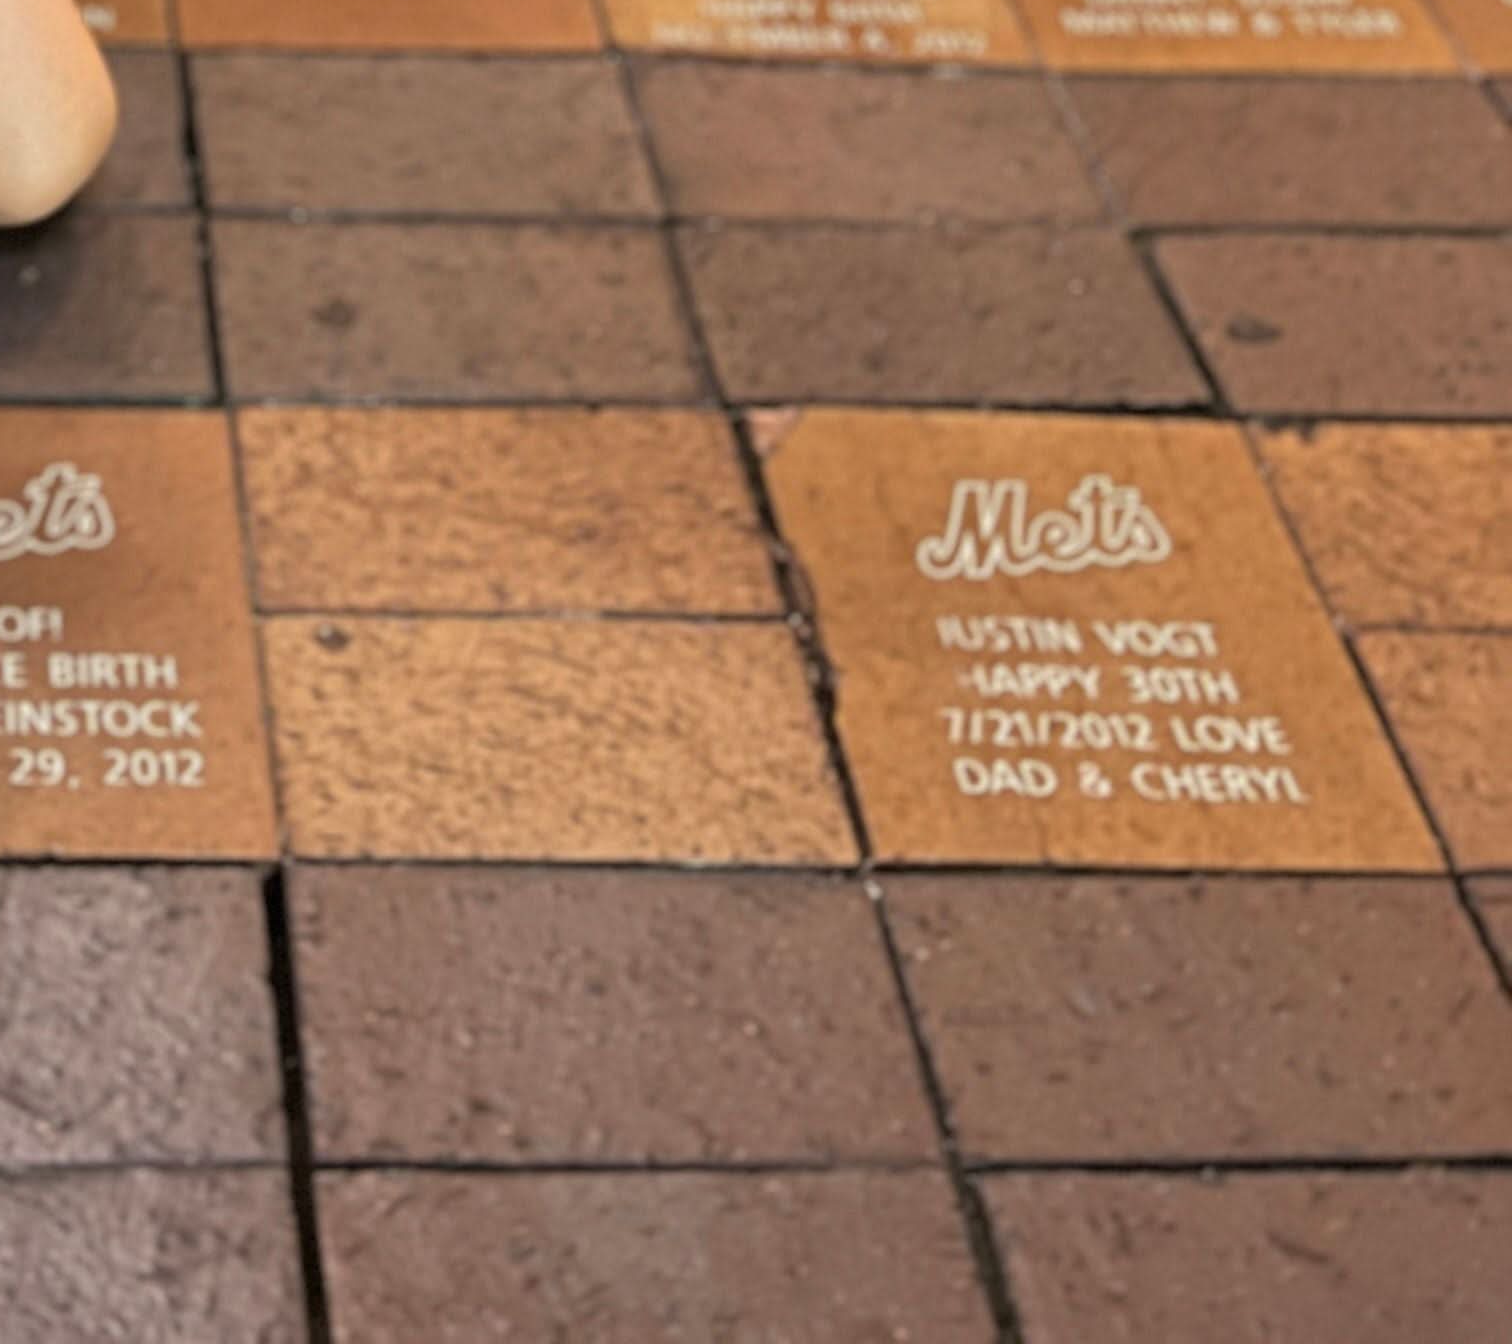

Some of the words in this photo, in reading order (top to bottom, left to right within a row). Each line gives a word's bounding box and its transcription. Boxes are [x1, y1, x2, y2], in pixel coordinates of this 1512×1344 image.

[915, 472, 1174, 580] Mets
[1093, 620, 1217, 658] VOGT
[48, 653, 178, 688] BIRTH
[941, 707, 1156, 752] 7/21/2012
[1170, 715, 1290, 755] LOVE
[9, 748, 80, 789] 29,
[103, 748, 204, 787] 2012
[953, 757, 1059, 797] DAD
[1078, 762, 1113, 798] &
[1130, 762, 1309, 803] CHERYL
